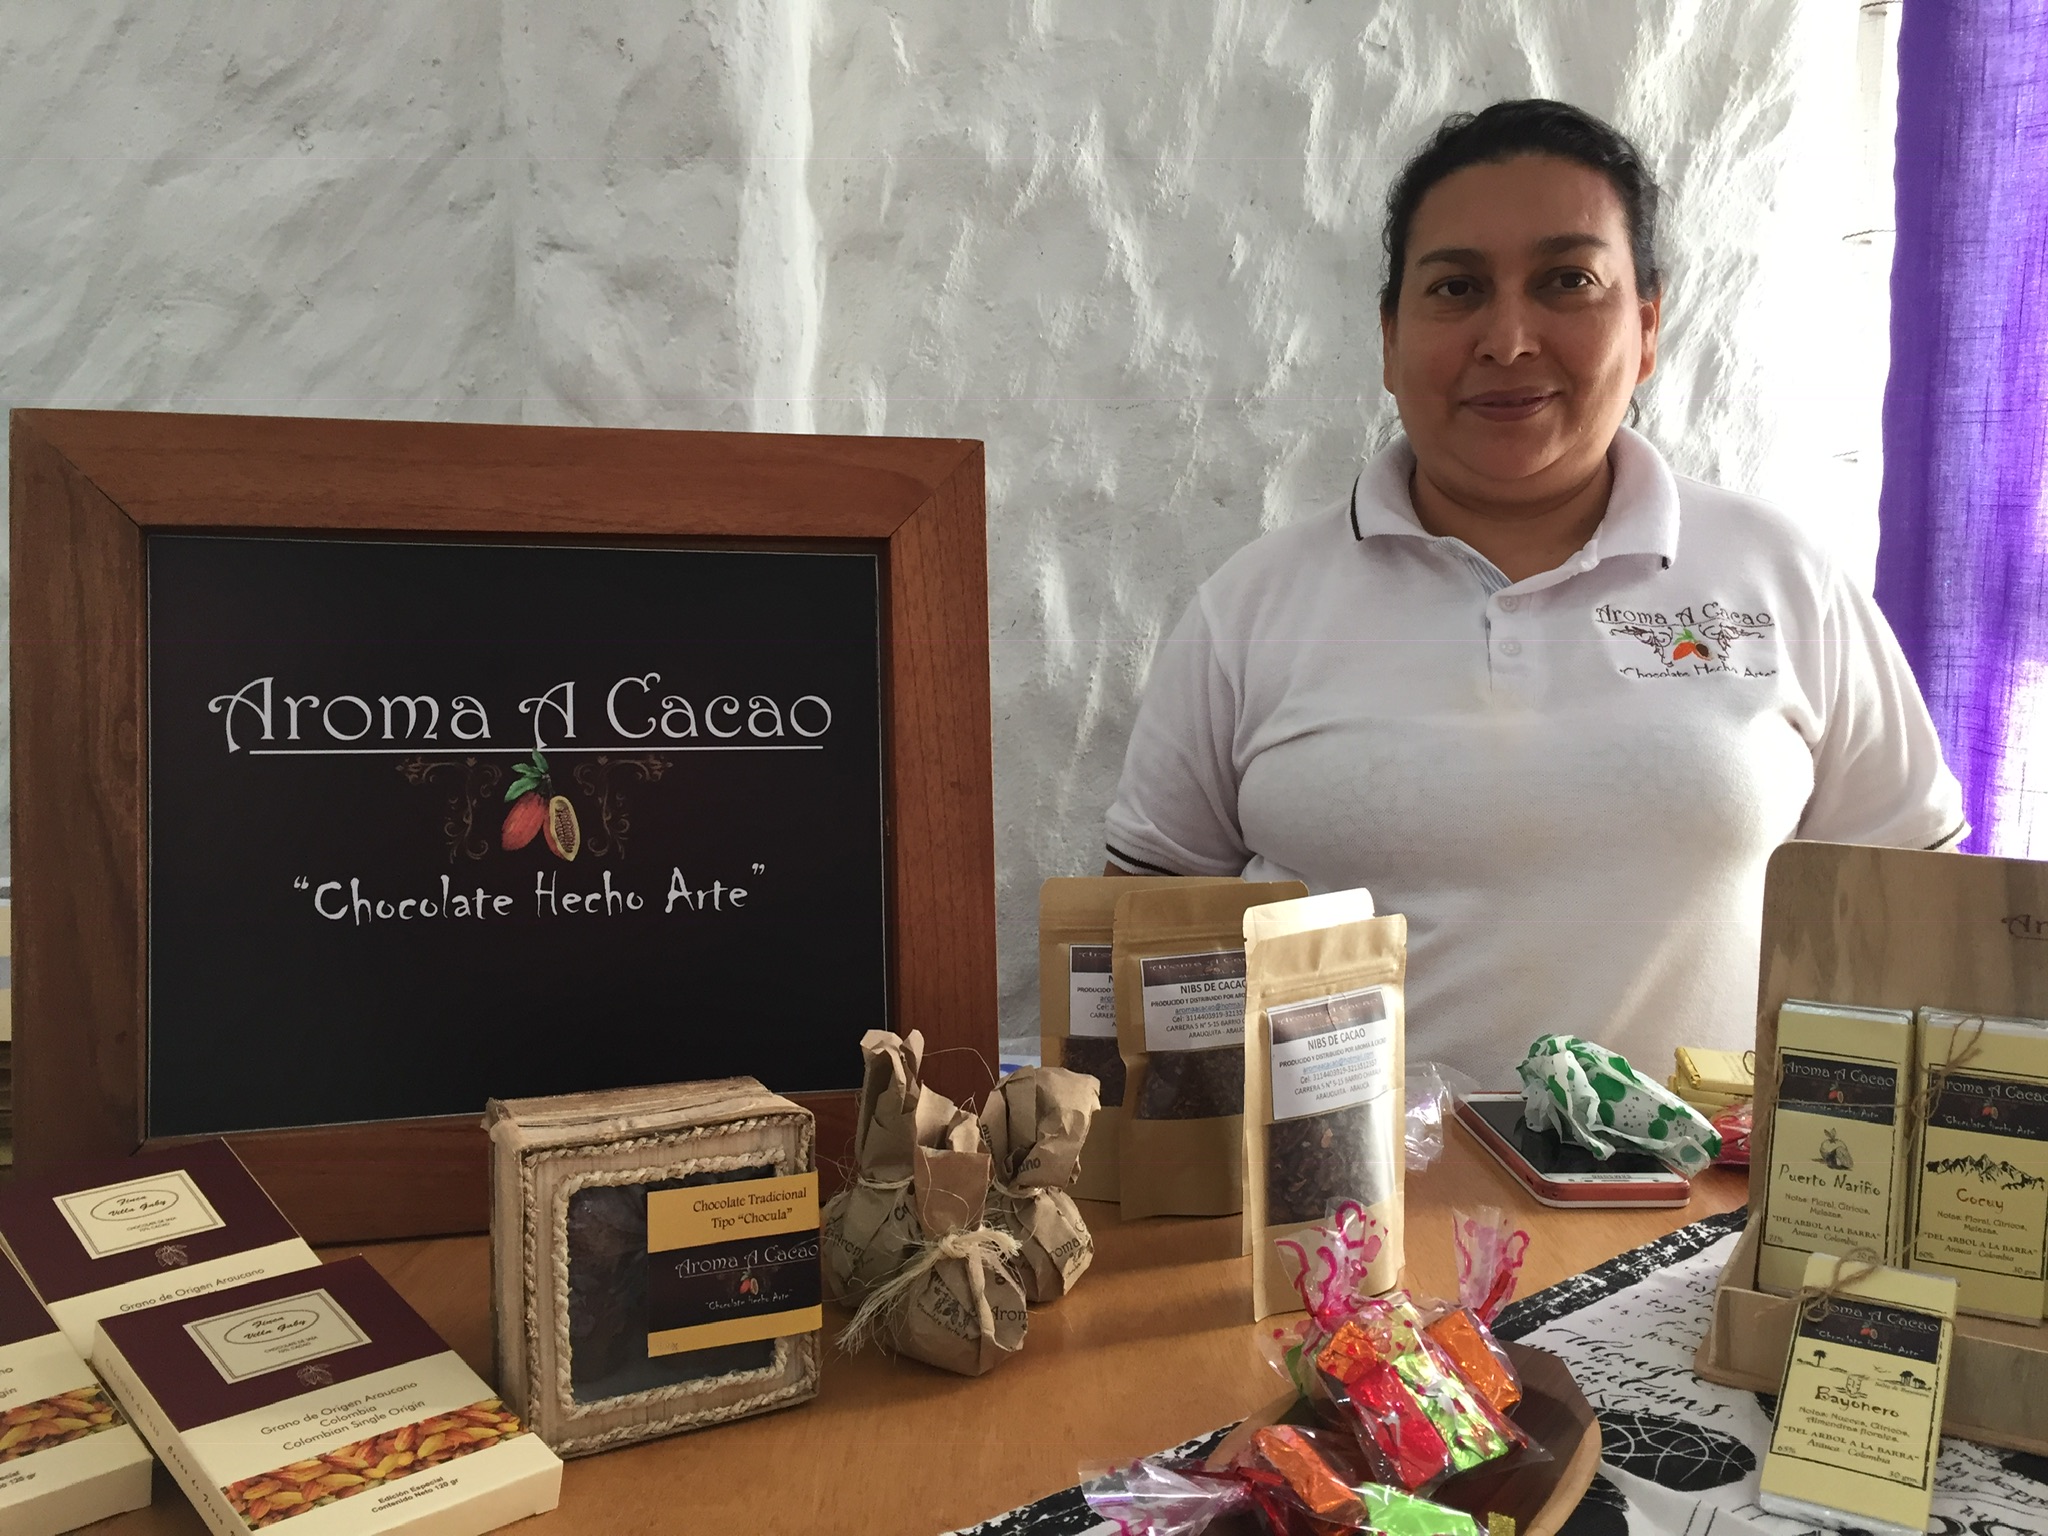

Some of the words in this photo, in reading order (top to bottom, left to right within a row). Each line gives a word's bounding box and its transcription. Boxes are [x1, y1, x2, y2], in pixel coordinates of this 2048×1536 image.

[1596, 604, 1667, 626] Aroma
[1675, 607, 1694, 627] A
[1702, 602, 1771, 624] Cacao
[208, 676, 492, 754] Aroma
[518, 680, 576, 749] A
[605, 672, 833, 741] Cacao
[293, 874, 514, 927] “Chocolate
[536, 870, 645, 917] Hecho
[665, 863, 766, 913] Arte”
[1180, 983, 1202, 994] NIBS
[1204, 982, 1216, 991] DE
[1151, 999, 1185, 1007] PRODUCIDO
[1166, 1024, 1194, 1033] CARRERA
[1189, 1029, 1221, 1038] ARAUQUITA
[1308, 1038, 1326, 1050] NIBS
[1328, 1034, 1338, 1046] DE
[1340, 1028, 1366, 1043] CACAO
[1279, 1053, 1310, 1068] PRODUCIDO
[1316, 1049, 1344, 1060] DISTRIBUIDO
[1782, 1061, 1830, 1079] Aroma
[1834, 1067, 1846, 1081] A
[1850, 1069, 1895, 1087] Cacao
[1295, 1084, 1320, 1096] CARRERA
[1350, 1082, 1369, 1092] ARAUCA
[1988, 1084, 2001, 1098] A
[1779, 1163, 1827, 1188] Puerto
[1834, 1174, 1881, 1197] Nariño
[116, 1194, 147, 1207] Finca
[693, 1196, 745, 1213] Chocolate
[748, 1187, 807, 1206] Tradicional
[1956, 1188, 2004, 1214] Cocuy
[108, 1207, 136, 1218] Villa
[711, 1217, 735, 1230] Tipo
[738, 1208, 793, 1224] “Chocula”
[1792, 1227, 1818, 1239] Arauca
[1794, 1218, 1824, 1230] ARBOL
[1833, 1226, 1845, 1234] LA
[1946, 1235, 1978, 1245] ARBOL
[1979, 1239, 1987, 1247] A
[1989, 1241, 2000, 1250] LA
[675, 1255, 738, 1278] Aroma
[743, 1249, 758, 1269] A
[764, 1243, 819, 1264] Cacao
[1978, 1248, 2014, 1262] Colombia
[120, 1296, 156, 1312] Grano
[159, 1292, 173, 1303] de
[175, 1282, 214, 1297] Origen
[215, 1267, 265, 1286] Araucano
[243, 1328, 274, 1342] Villa
[276, 1318, 307, 1335] Gaby
[251, 1315, 286, 1329] Finca
[1868, 1307, 1881, 1322] A
[1887, 1313, 1939, 1332] Cacao
[260, 1415, 301, 1436] Grano
[303, 1411, 318, 1425] de
[320, 1398, 361, 1420] Origen
[363, 1380, 418, 1405] Araucano
[319, 1403, 377, 1428] Colombia
[282, 1426, 348, 1452] Colombian
[349, 1415, 385, 1435] Single
[387, 1399, 426, 1421] Origin
[1807, 1438, 1840, 1452] Arauca
[1847, 1447, 1891, 1465] Colombia
[1811, 1431, 1846, 1444] ARBOL
[1860, 1442, 1874, 1451] LA
[371, 1498, 412, 1514] Contenido
[413, 1489, 433, 1501] Neto
[434, 1486, 448, 1496] 120
[449, 1477, 460, 1489] gr
[378, 1487, 409, 1504] Edición
[411, 1476, 444, 1497] Especial
